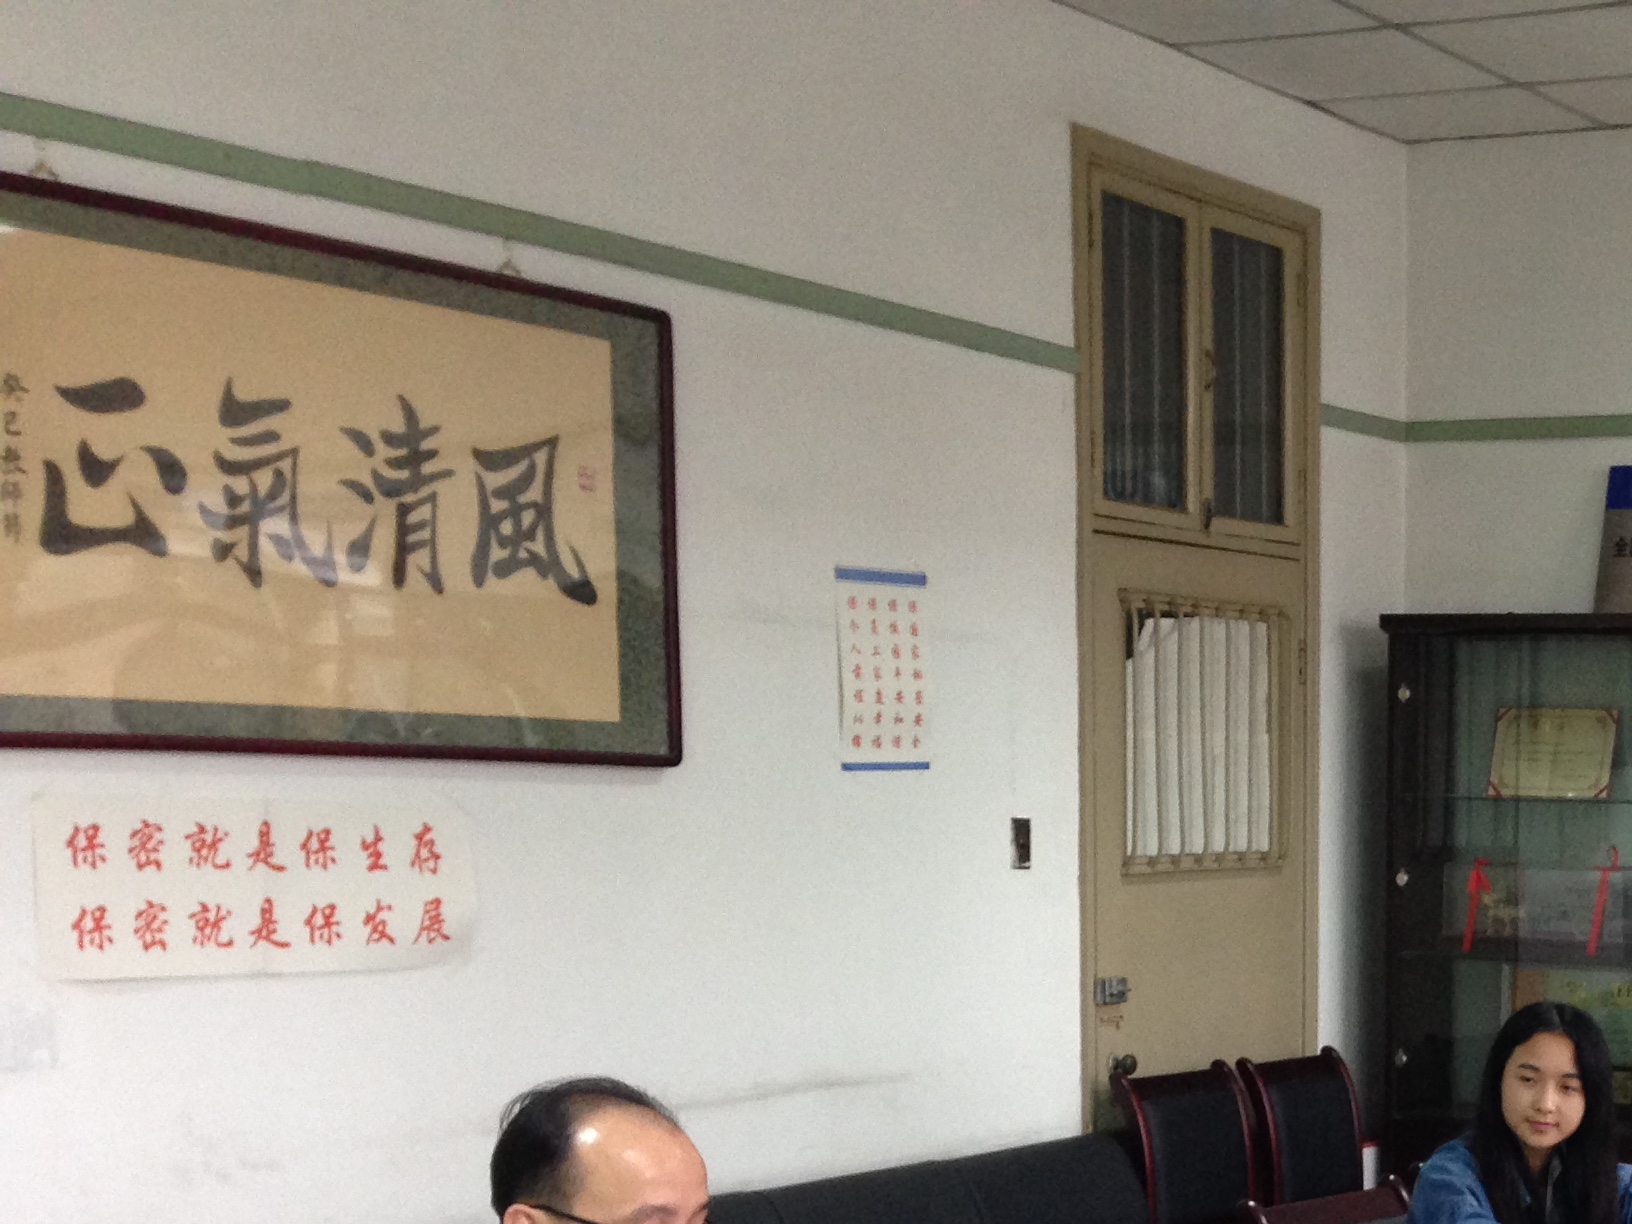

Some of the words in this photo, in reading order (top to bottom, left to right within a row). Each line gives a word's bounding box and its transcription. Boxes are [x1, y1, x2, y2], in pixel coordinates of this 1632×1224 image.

[65, 819, 443, 876] 保密就是保生存
[71, 896, 452, 952] 保密就是保发展
